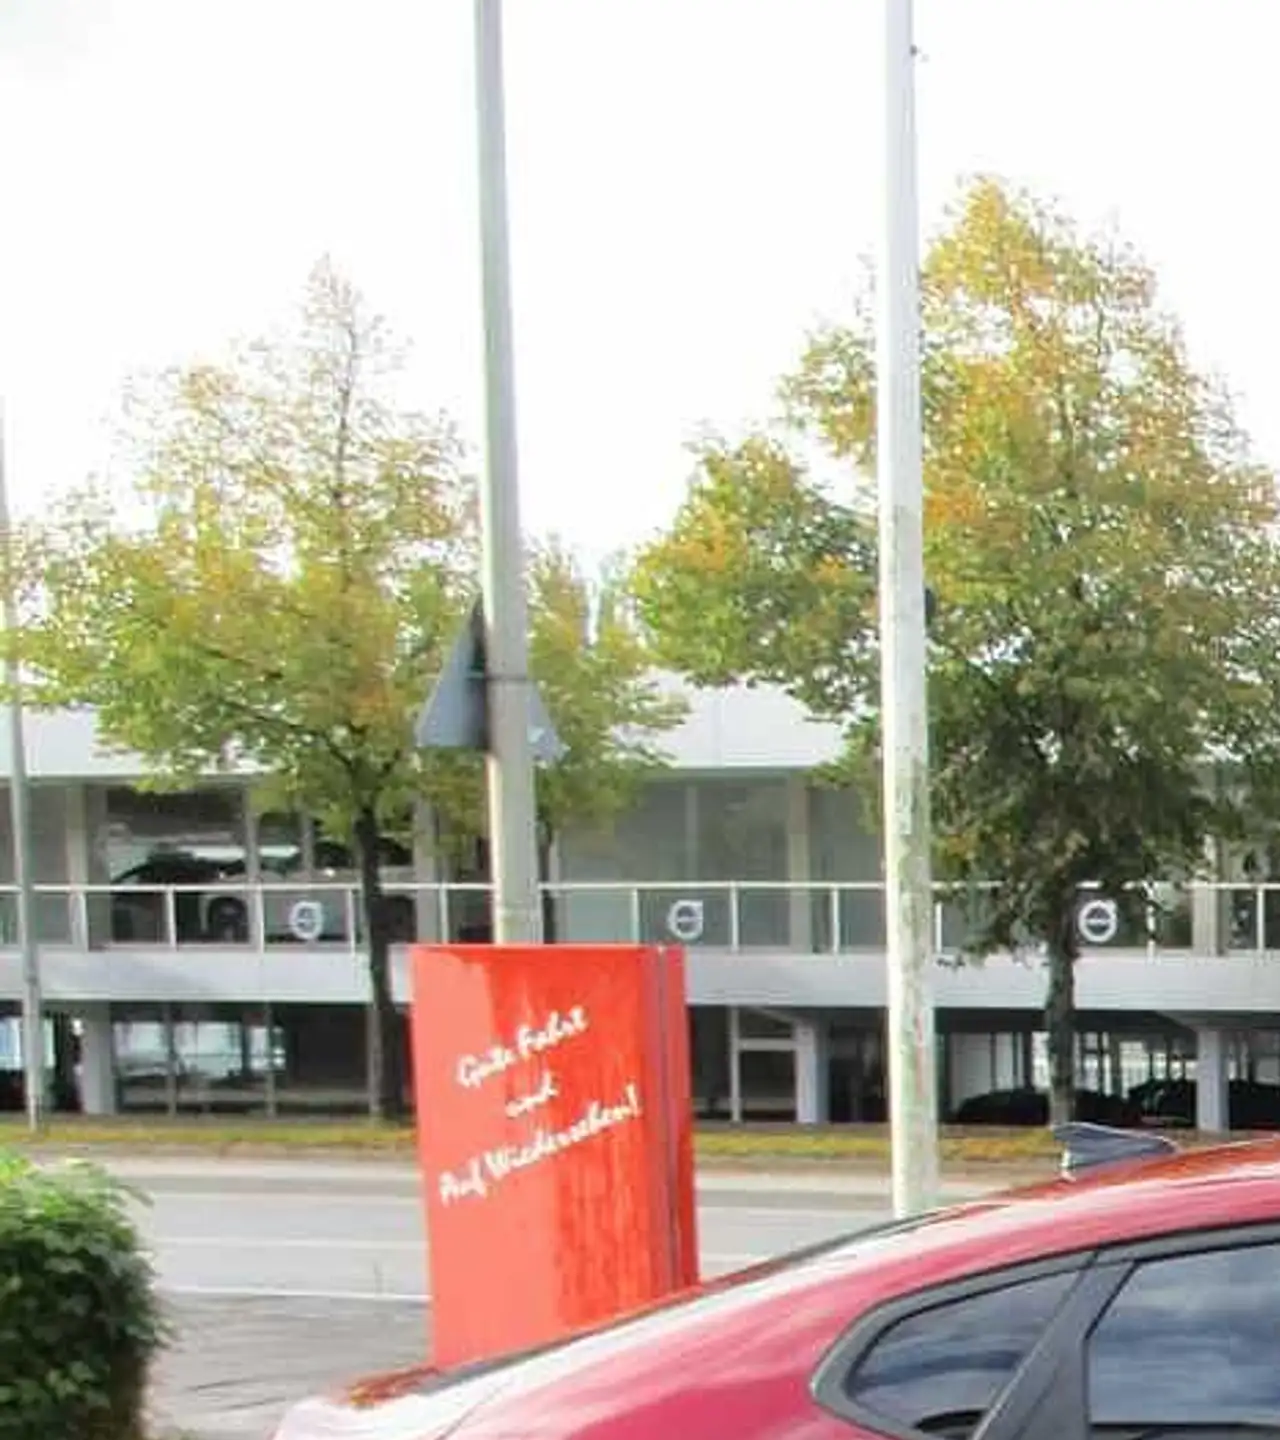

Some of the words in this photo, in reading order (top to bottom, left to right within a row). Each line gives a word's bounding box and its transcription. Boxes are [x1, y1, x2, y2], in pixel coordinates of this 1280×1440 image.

[458, 1047, 516, 1089] Gute
[517, 1006, 587, 1060] Fahrt
[506, 1071, 558, 1118] und
[440, 1158, 487, 1207] Auf
[484, 1082, 643, 1180] Wiedersehen!
